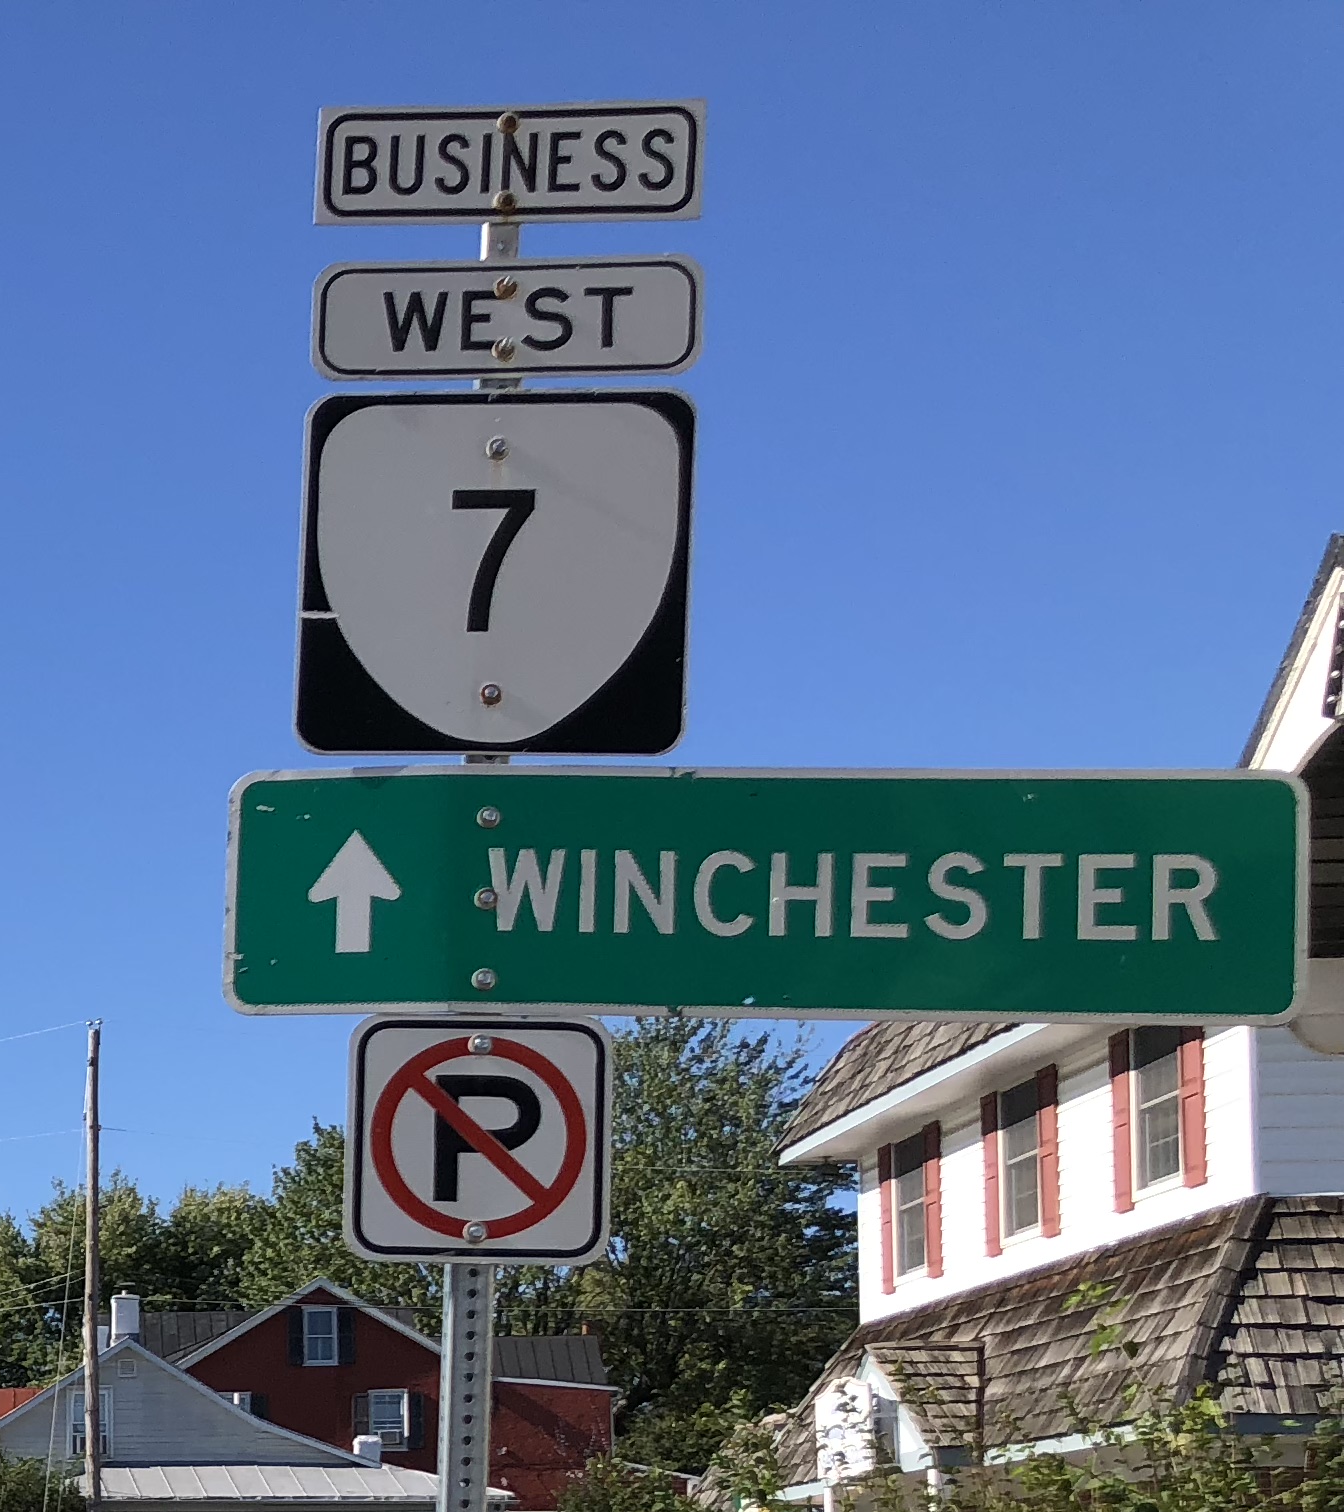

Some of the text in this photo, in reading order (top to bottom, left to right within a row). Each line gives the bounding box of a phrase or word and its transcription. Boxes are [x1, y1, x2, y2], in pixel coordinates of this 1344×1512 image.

[342, 129, 674, 195] BUSINESS
[383, 287, 633, 352] WEST
[452, 489, 536, 632] 7
[488, 847, 1219, 941] WINCHESTER
